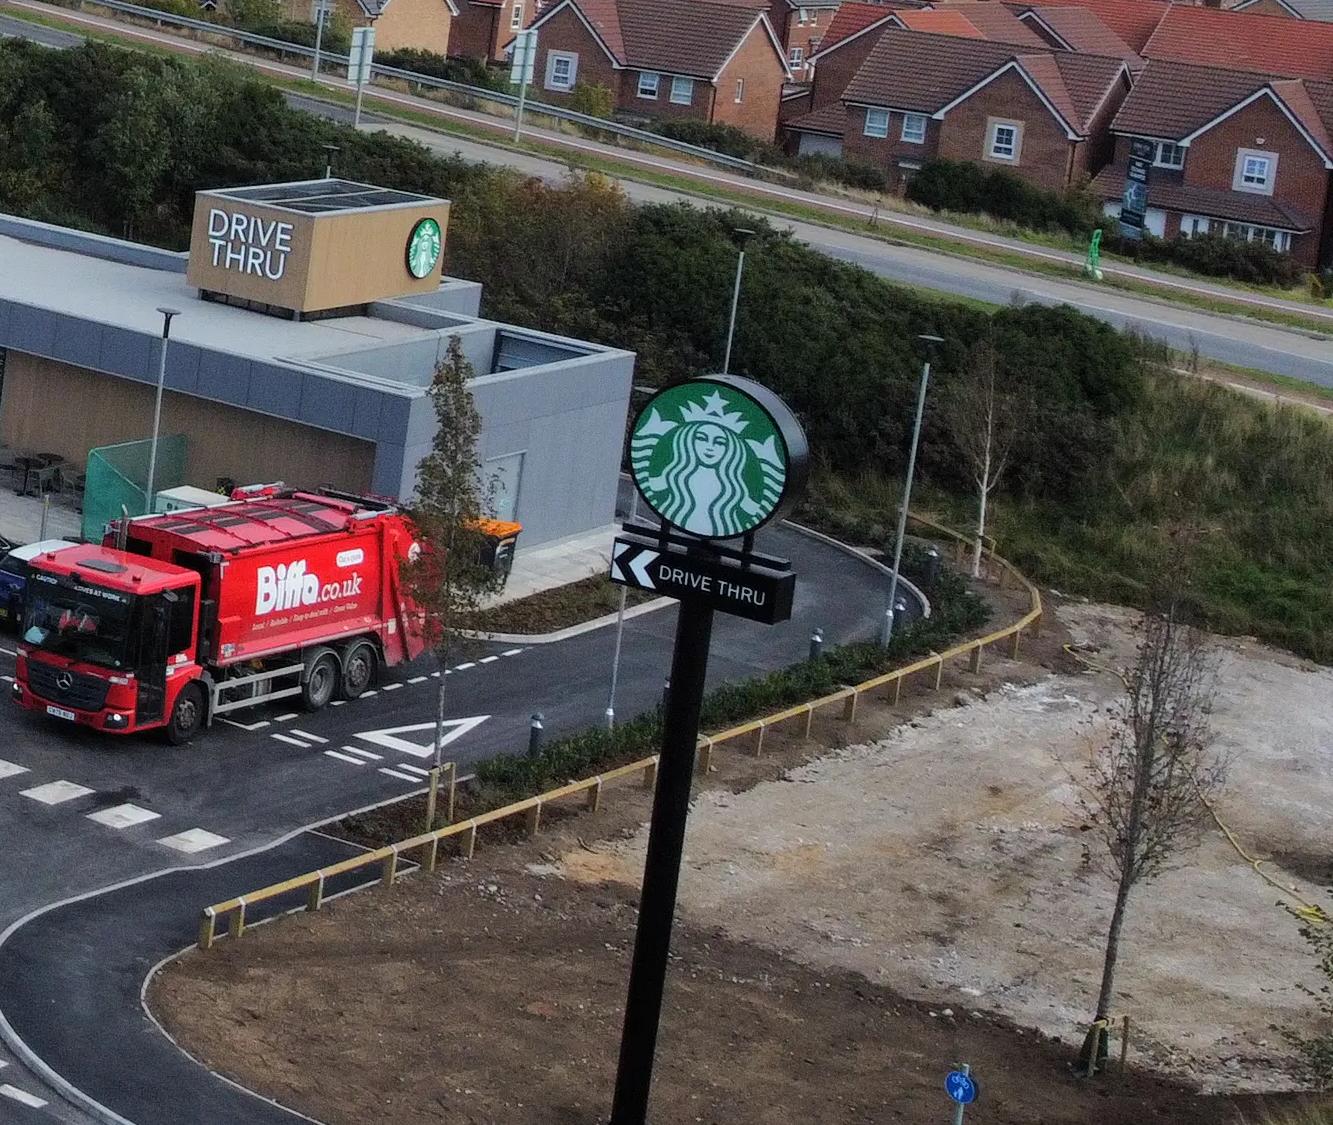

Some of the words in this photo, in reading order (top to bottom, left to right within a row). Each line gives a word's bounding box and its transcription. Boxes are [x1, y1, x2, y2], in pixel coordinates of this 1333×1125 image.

[208, 209, 293, 252] DRIVE
[209, 238, 285, 280] THRU
[255, 559, 363, 615] Biffa.co.uk
[659, 565, 712, 592] DRIVE
[717, 580, 766, 606] THRU
